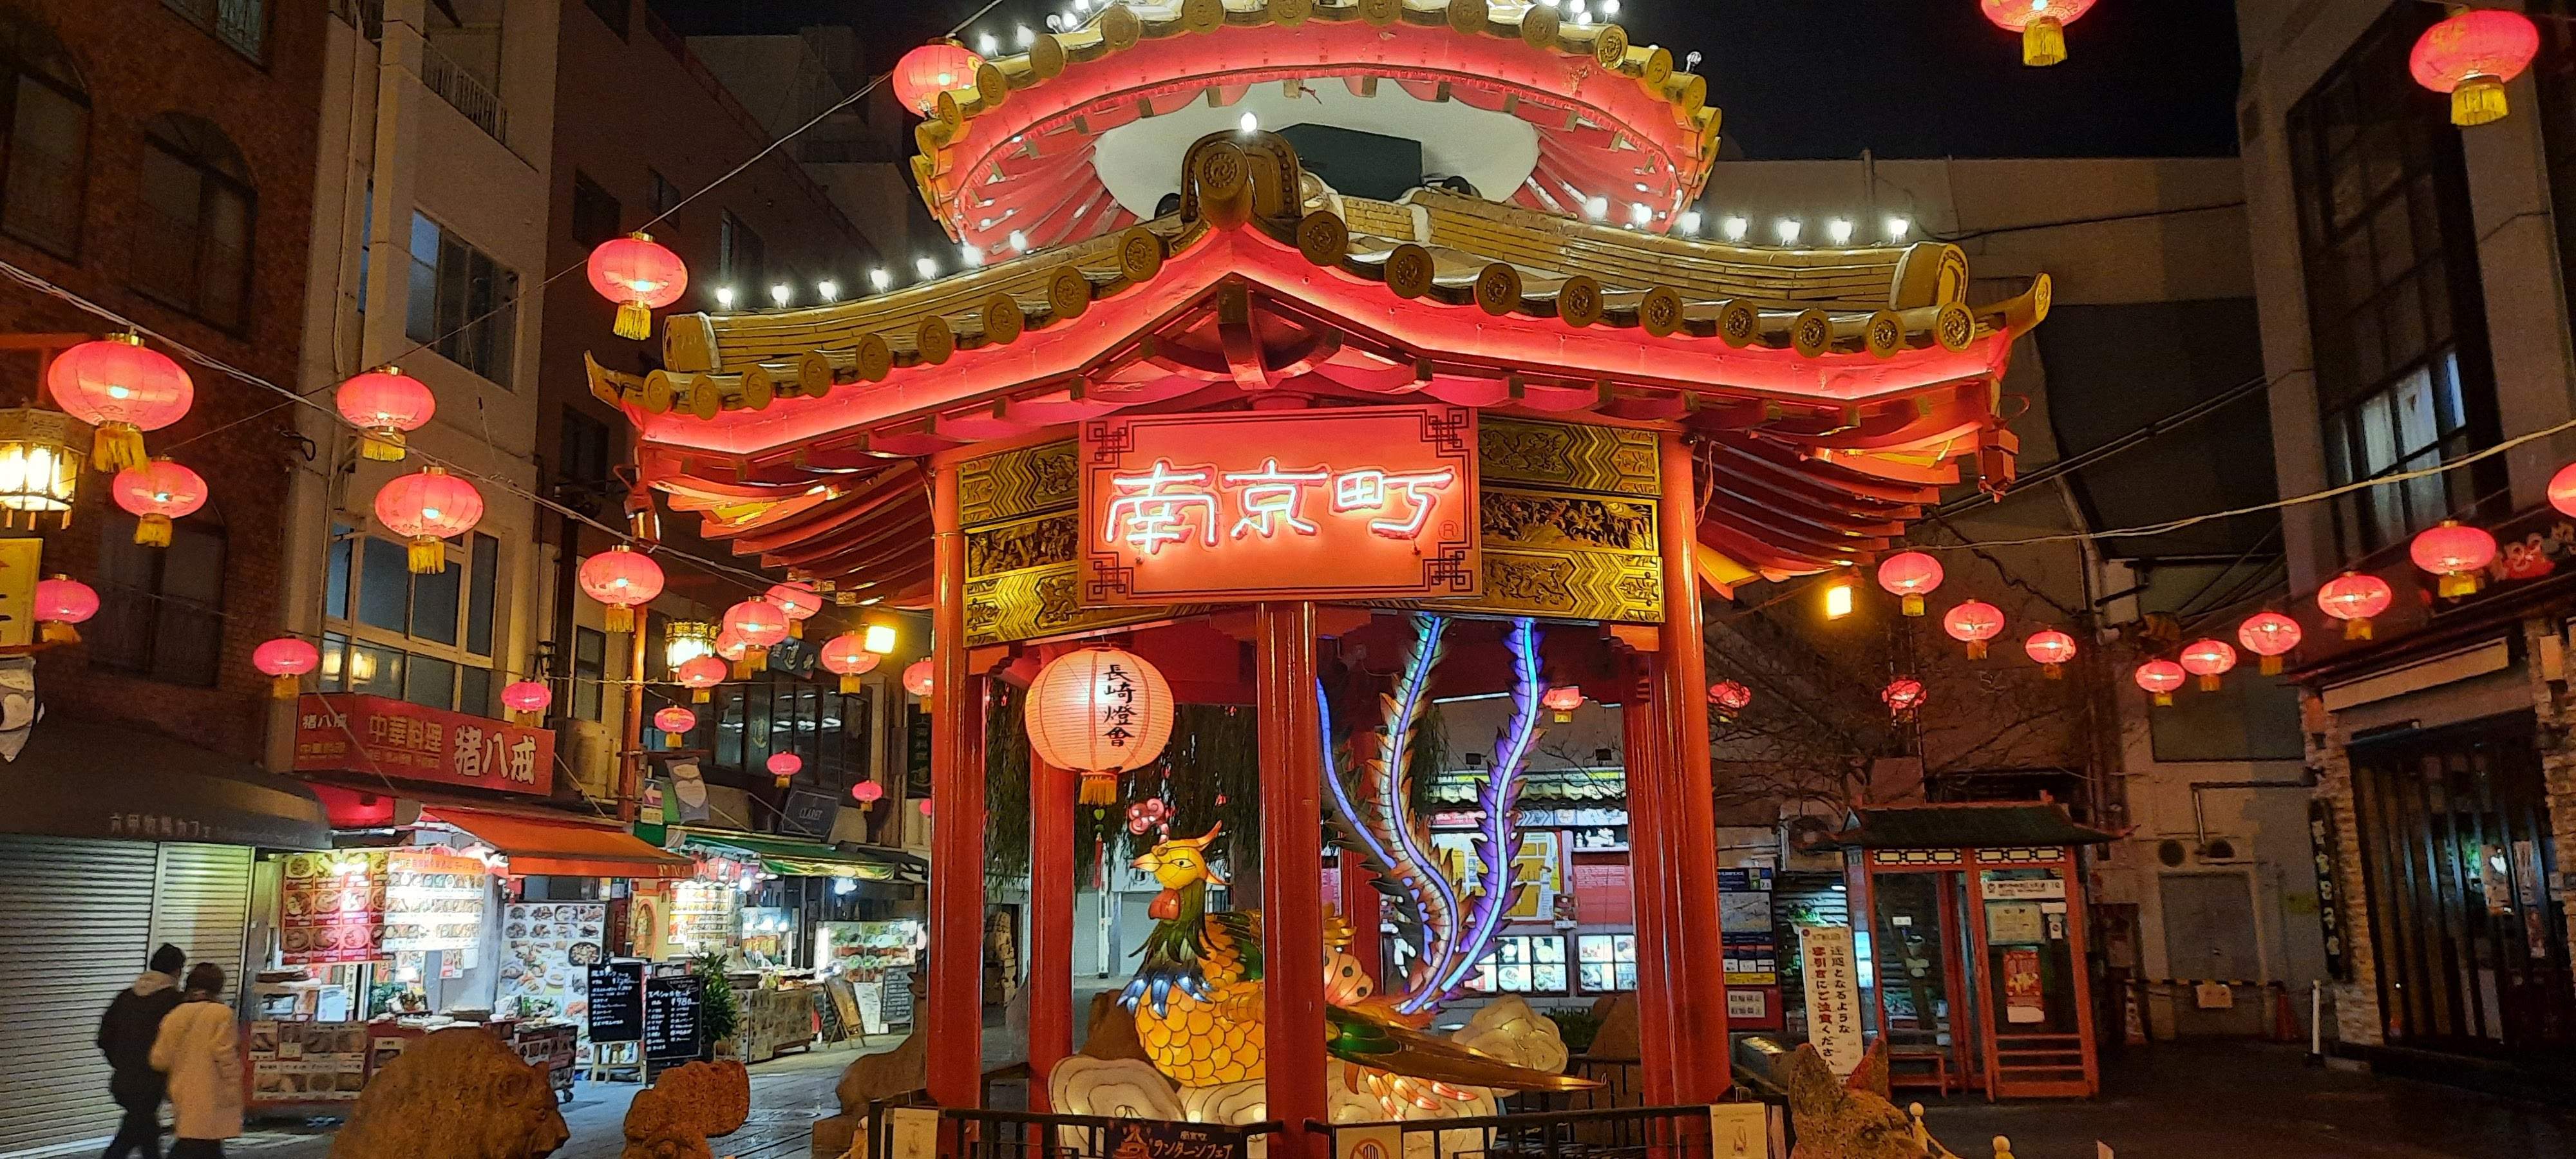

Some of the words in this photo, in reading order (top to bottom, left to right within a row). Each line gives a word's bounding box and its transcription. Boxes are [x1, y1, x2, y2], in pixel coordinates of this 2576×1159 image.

[1103, 459, 1455, 554] 南京町
[368, 712, 444, 753] 中華料理
[1102, 664, 1138, 748] 長崎燈會
[453, 724, 537, 786] 猪八戒
